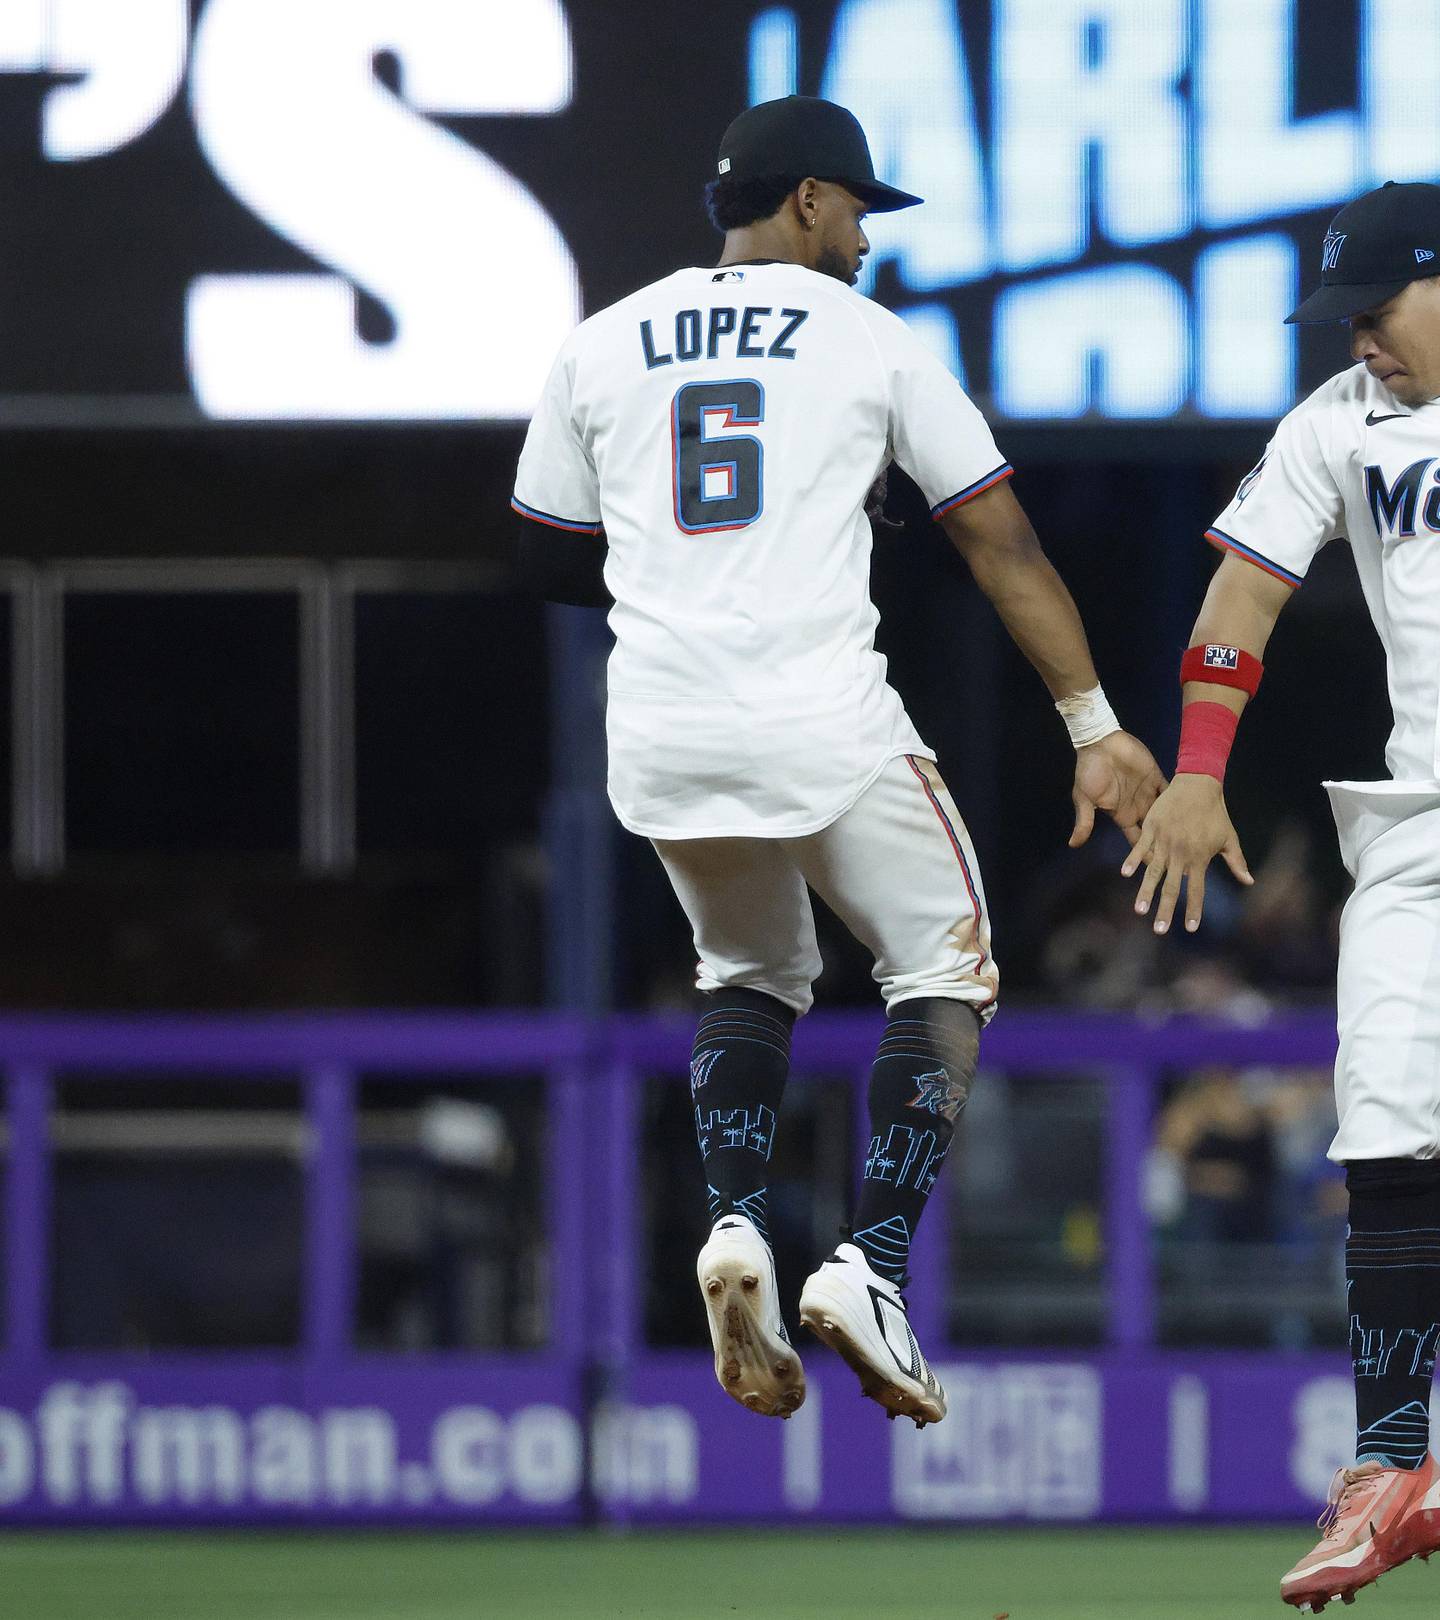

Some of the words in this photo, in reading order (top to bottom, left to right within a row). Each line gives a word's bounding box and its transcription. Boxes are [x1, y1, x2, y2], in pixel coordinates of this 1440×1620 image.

[0, 0, 582, 420] 'S
[640, 306, 809, 371] LOPEZ
[671, 377, 765, 536] 6
